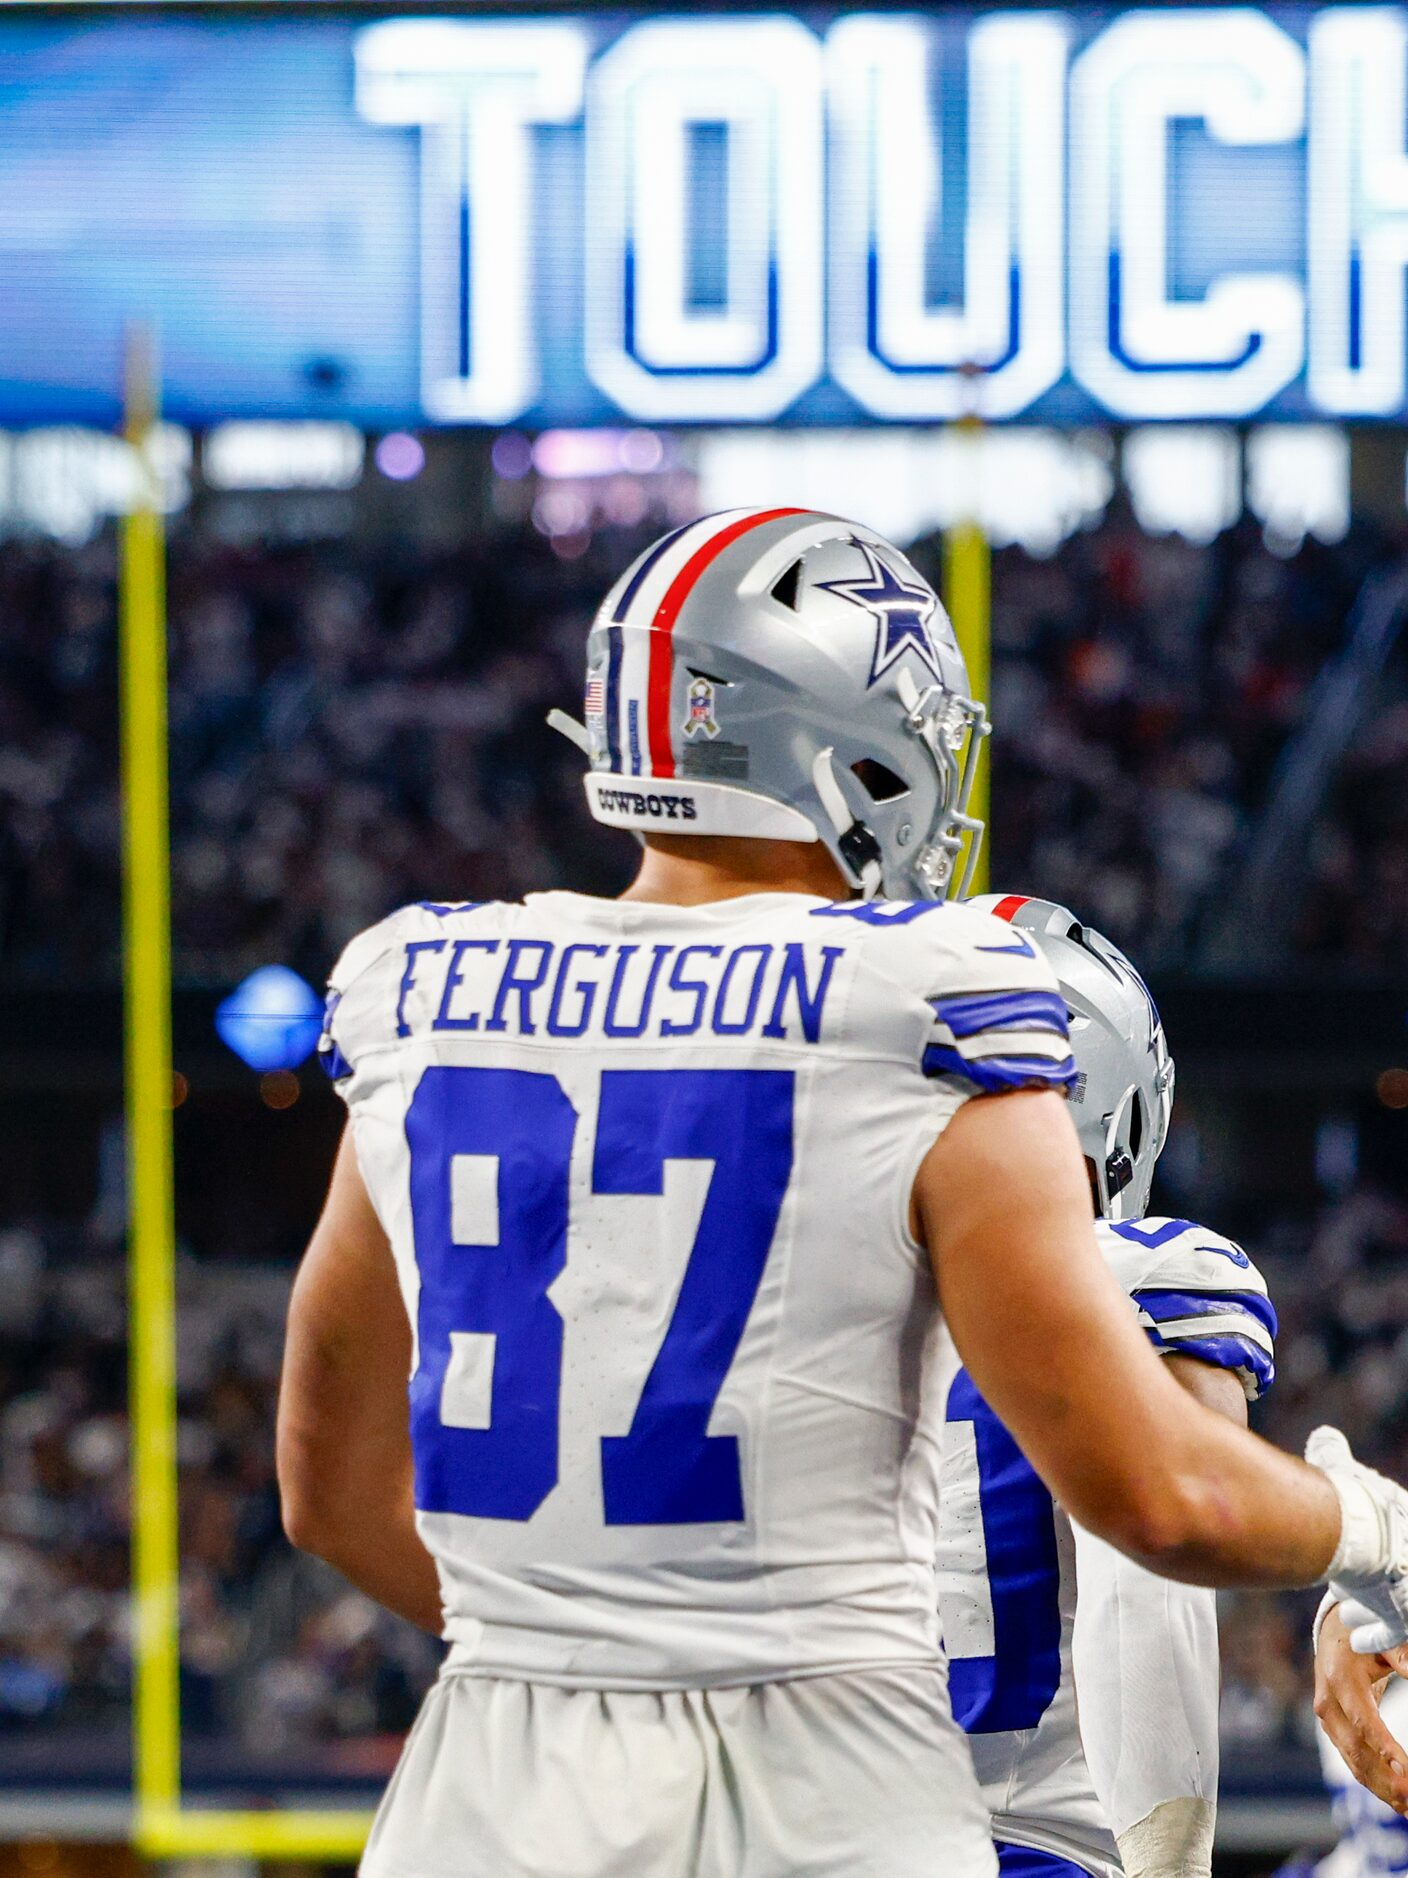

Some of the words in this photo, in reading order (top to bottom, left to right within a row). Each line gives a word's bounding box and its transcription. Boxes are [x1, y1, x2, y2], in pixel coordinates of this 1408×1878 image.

[598, 787, 697, 820] COWBOYS
[396, 939, 845, 1044] FERGUSON
[403, 1065, 797, 1526] 87
